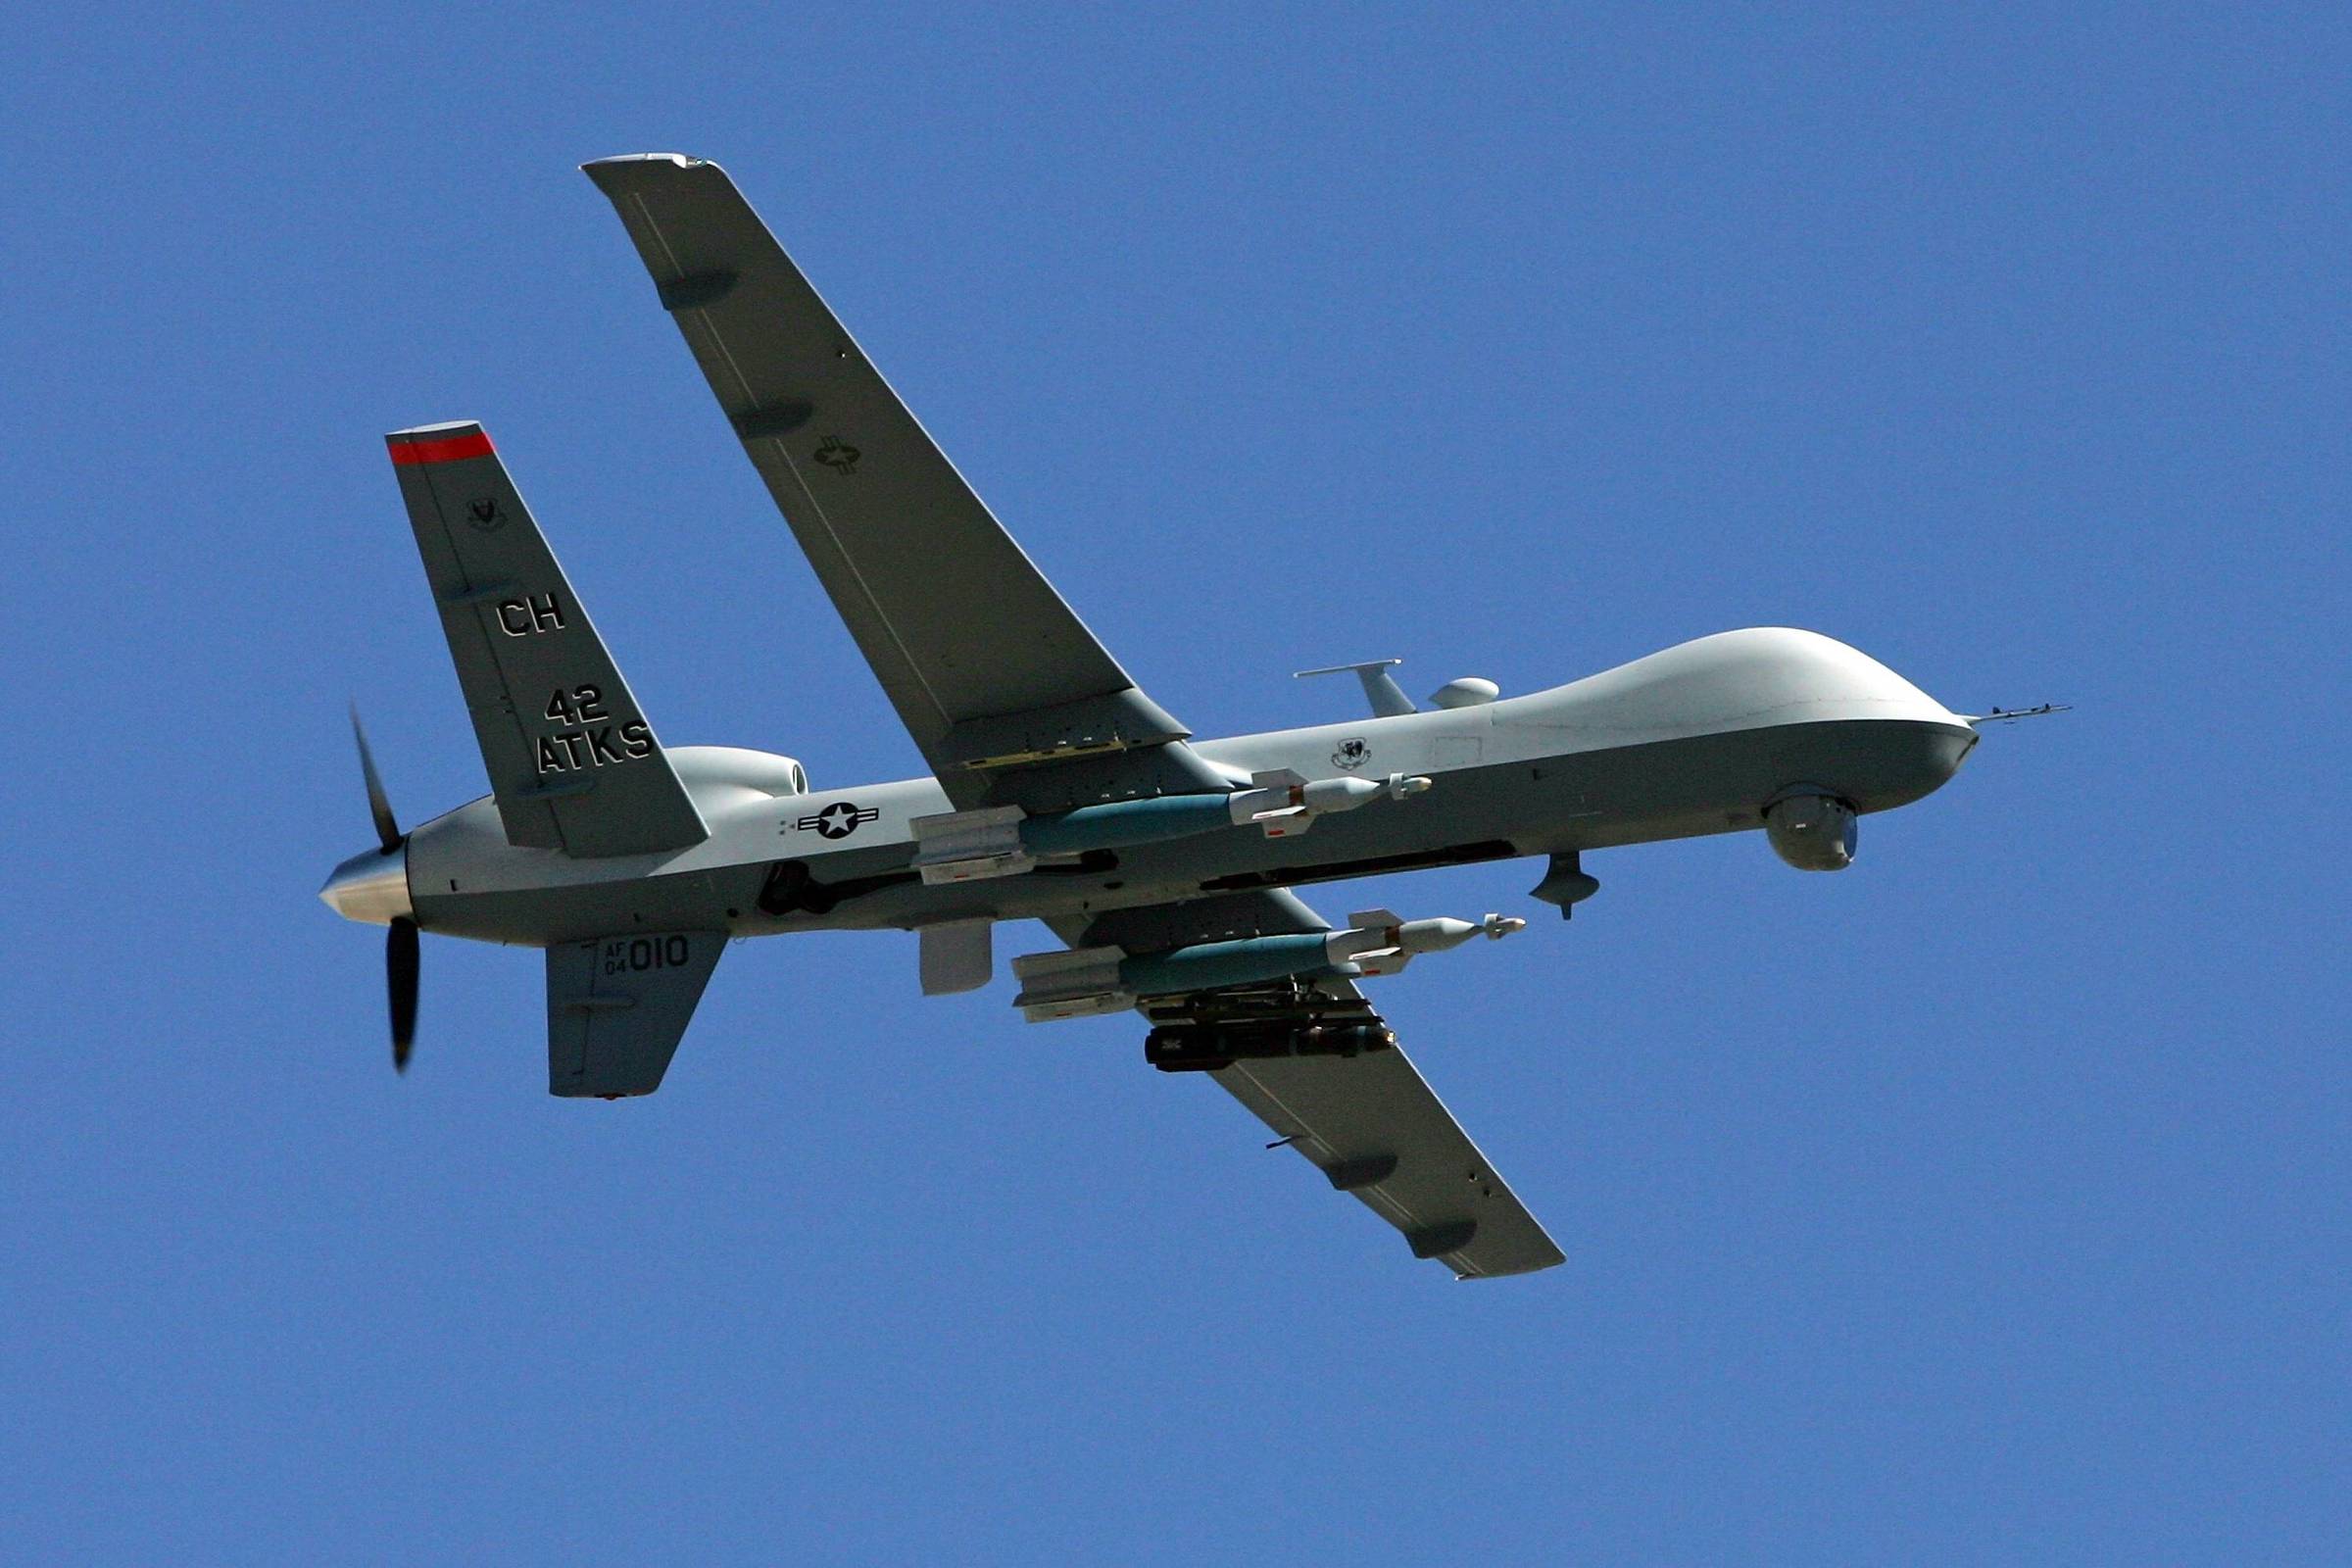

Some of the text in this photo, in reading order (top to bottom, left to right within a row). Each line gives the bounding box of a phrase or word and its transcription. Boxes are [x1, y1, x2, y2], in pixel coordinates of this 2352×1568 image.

[496, 592, 565, 637] CH
[544, 683, 609, 726] 42
[537, 719, 655, 774] ATKS
[605, 935, 689, 975] 04 010
[606, 942, 626, 957] AF
